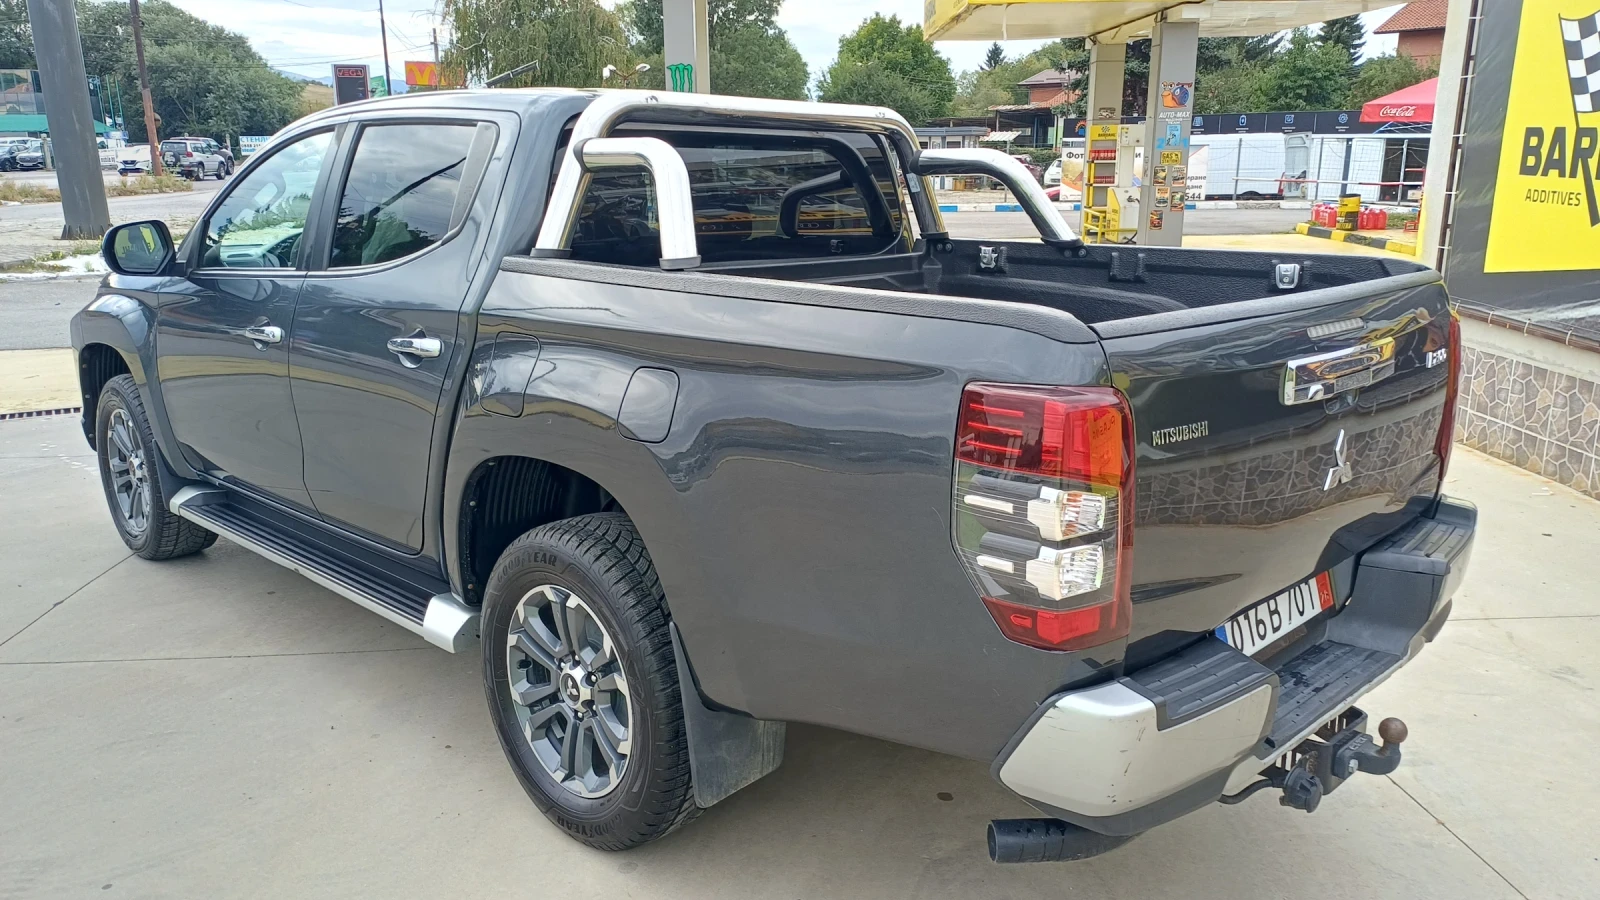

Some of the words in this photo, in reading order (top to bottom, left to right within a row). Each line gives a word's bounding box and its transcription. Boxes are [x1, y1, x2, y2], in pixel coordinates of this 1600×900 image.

[1159, 111, 1190, 119] AUTO-MAX
[1380, 105, 1417, 117] Coca-Cola
[1162, 152, 1174, 160] GAS
[1519, 126, 1600, 181] BAR
[1525, 188, 1582, 206] ADDITIVES
[1152, 420, 1209, 447] MITSUBISHI
[497, 550, 558, 584] GOODYEAR
